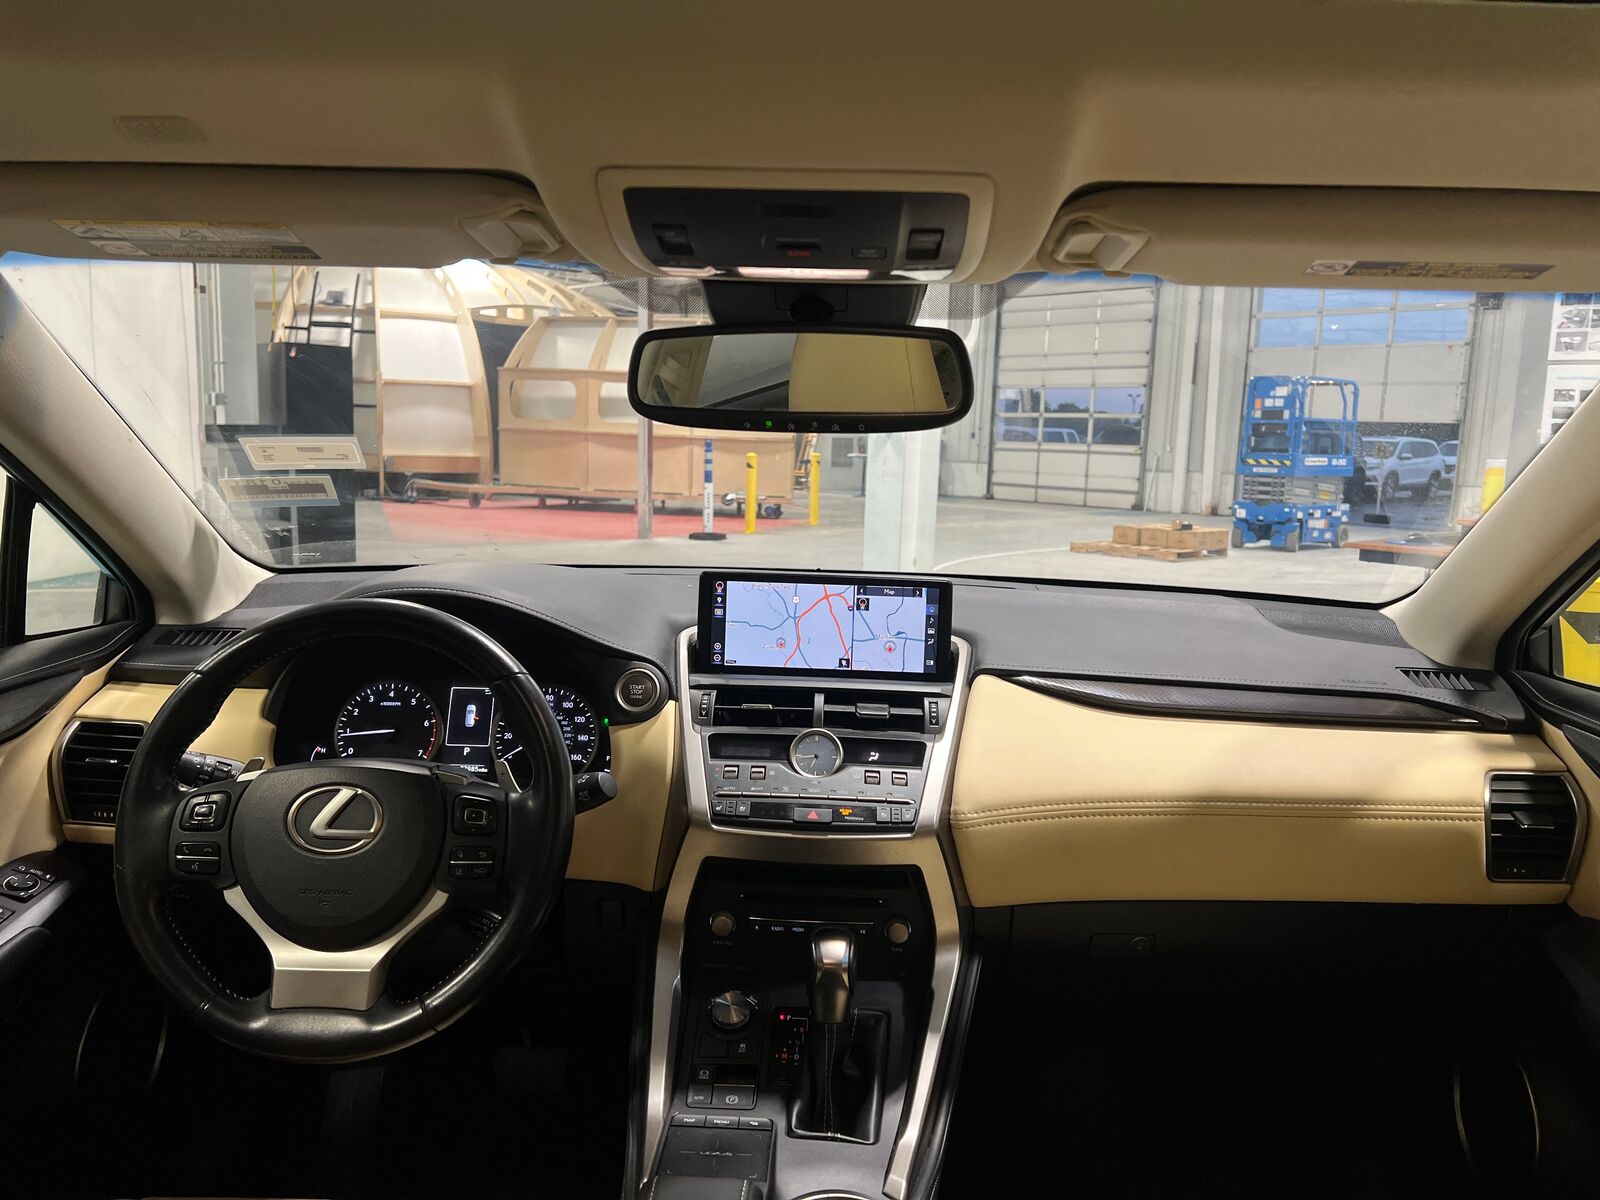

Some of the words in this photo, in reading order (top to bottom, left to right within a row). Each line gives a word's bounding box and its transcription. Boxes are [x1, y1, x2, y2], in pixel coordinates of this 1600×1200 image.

[353, 708, 359, 716] 2
[348, 747, 354, 755] 0
[463, 747, 471, 756] P
